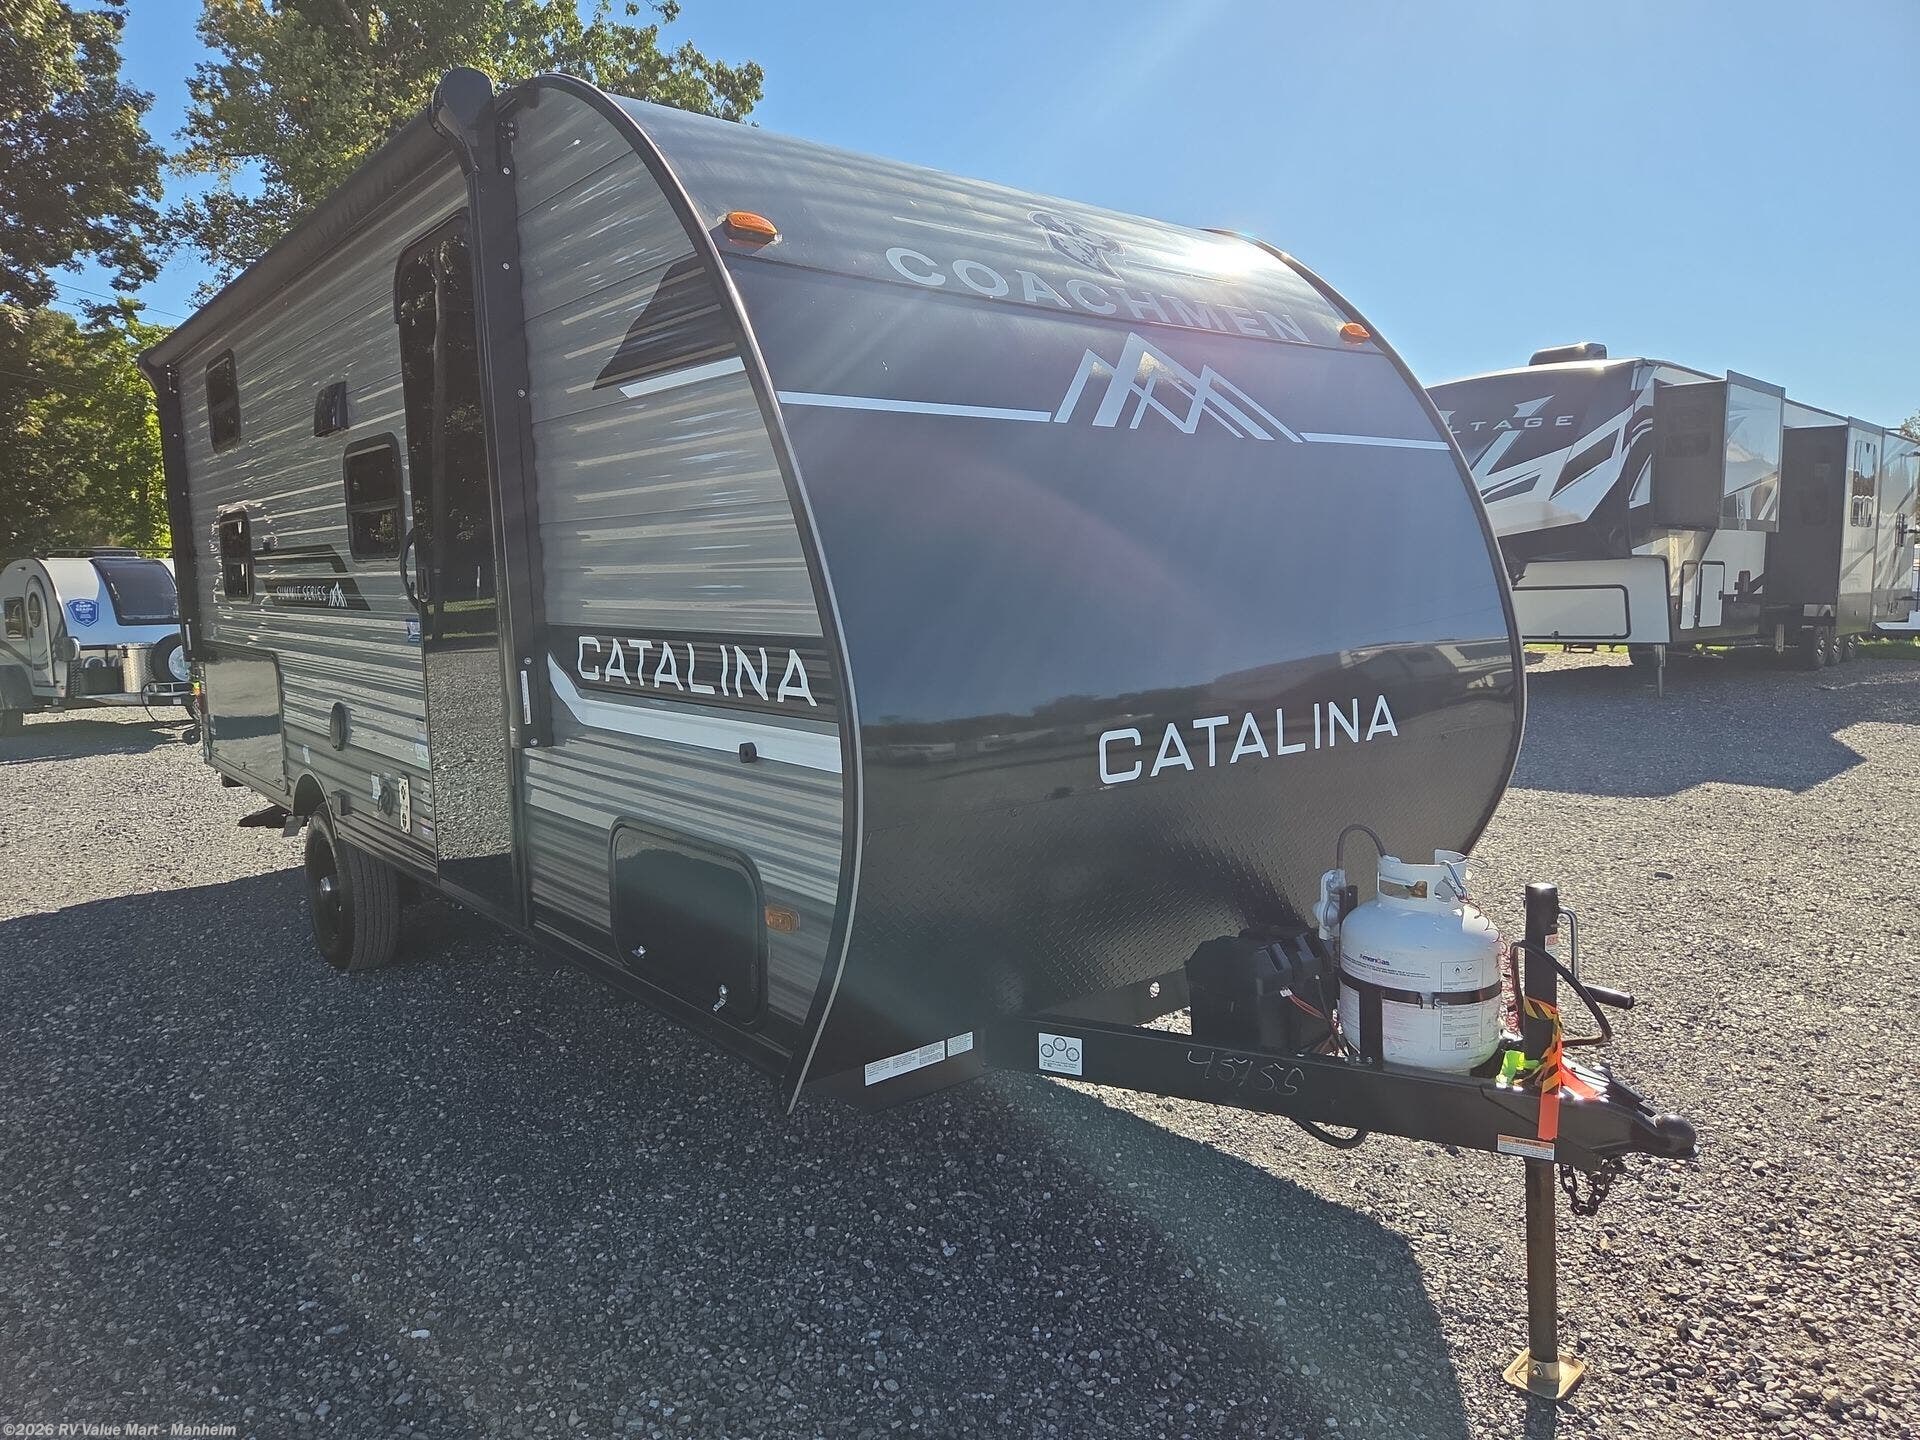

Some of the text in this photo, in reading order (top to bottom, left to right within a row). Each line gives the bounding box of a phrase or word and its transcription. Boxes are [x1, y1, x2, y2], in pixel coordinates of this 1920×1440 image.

[885, 246, 1311, 343] COACHMEN
[276, 585, 327, 601] SUMMIT SERIES
[577, 635, 818, 707] CATALINA
[1099, 694, 1399, 784] CATALINA
